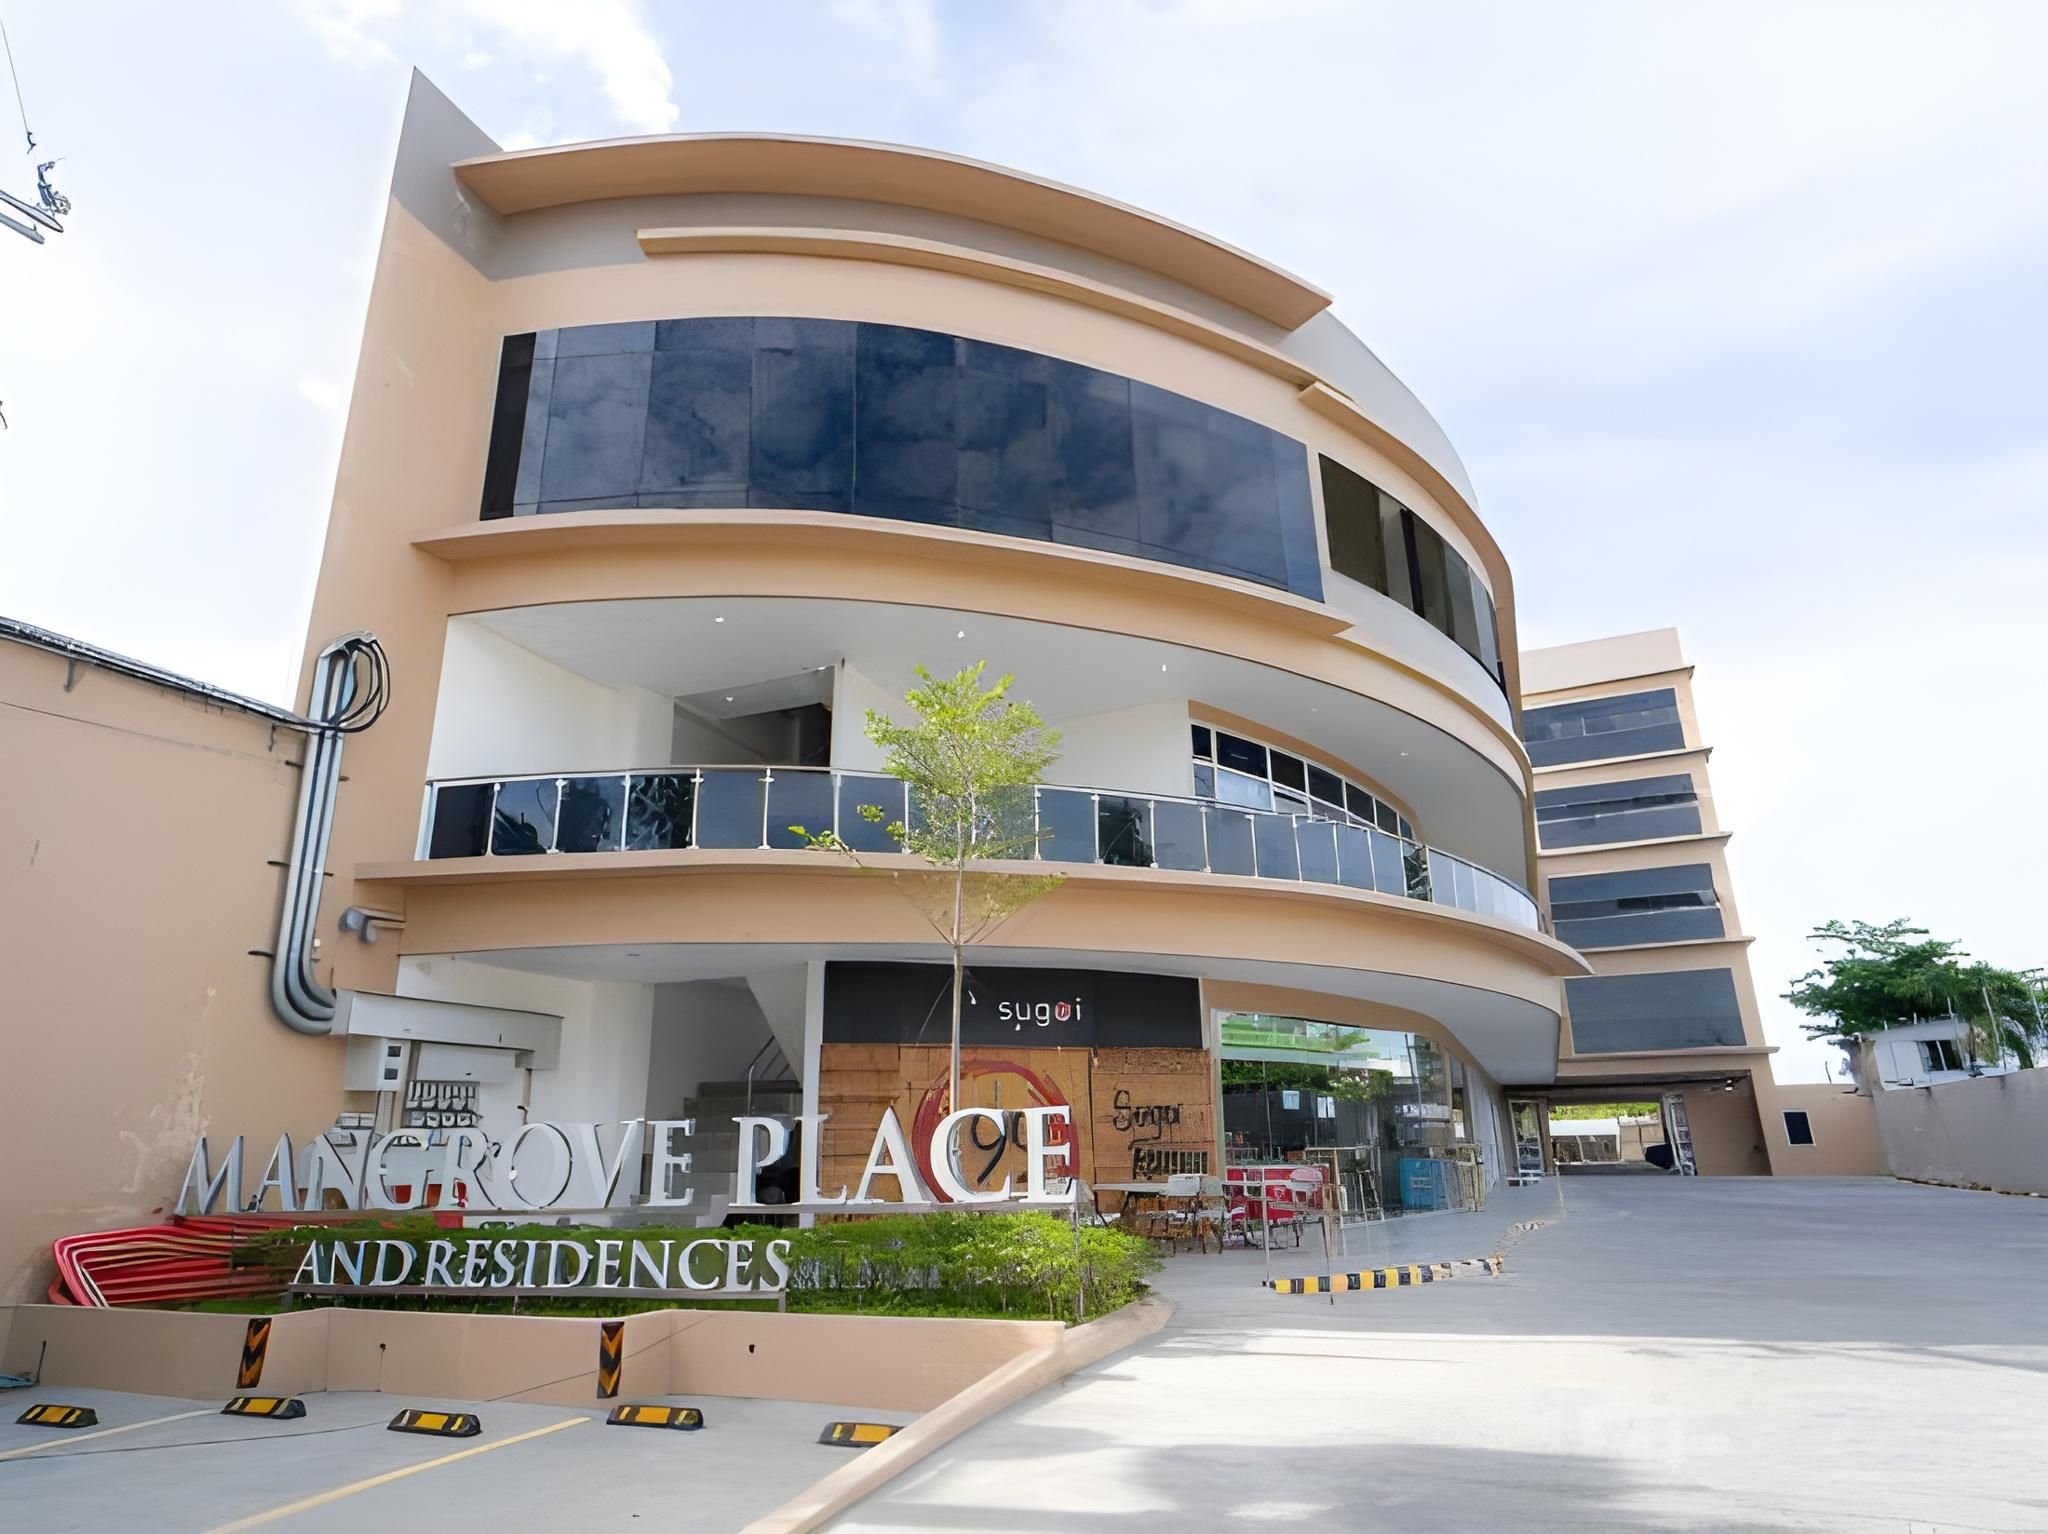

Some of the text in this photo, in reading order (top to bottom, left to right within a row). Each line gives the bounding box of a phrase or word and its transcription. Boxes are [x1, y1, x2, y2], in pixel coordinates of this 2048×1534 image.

[998, 997, 1082, 1029] sugoi
[174, 1117, 696, 1214] MANGROVE
[729, 1105, 1079, 1206] PLACE
[292, 1238, 791, 1292] AND RESIDENCES
